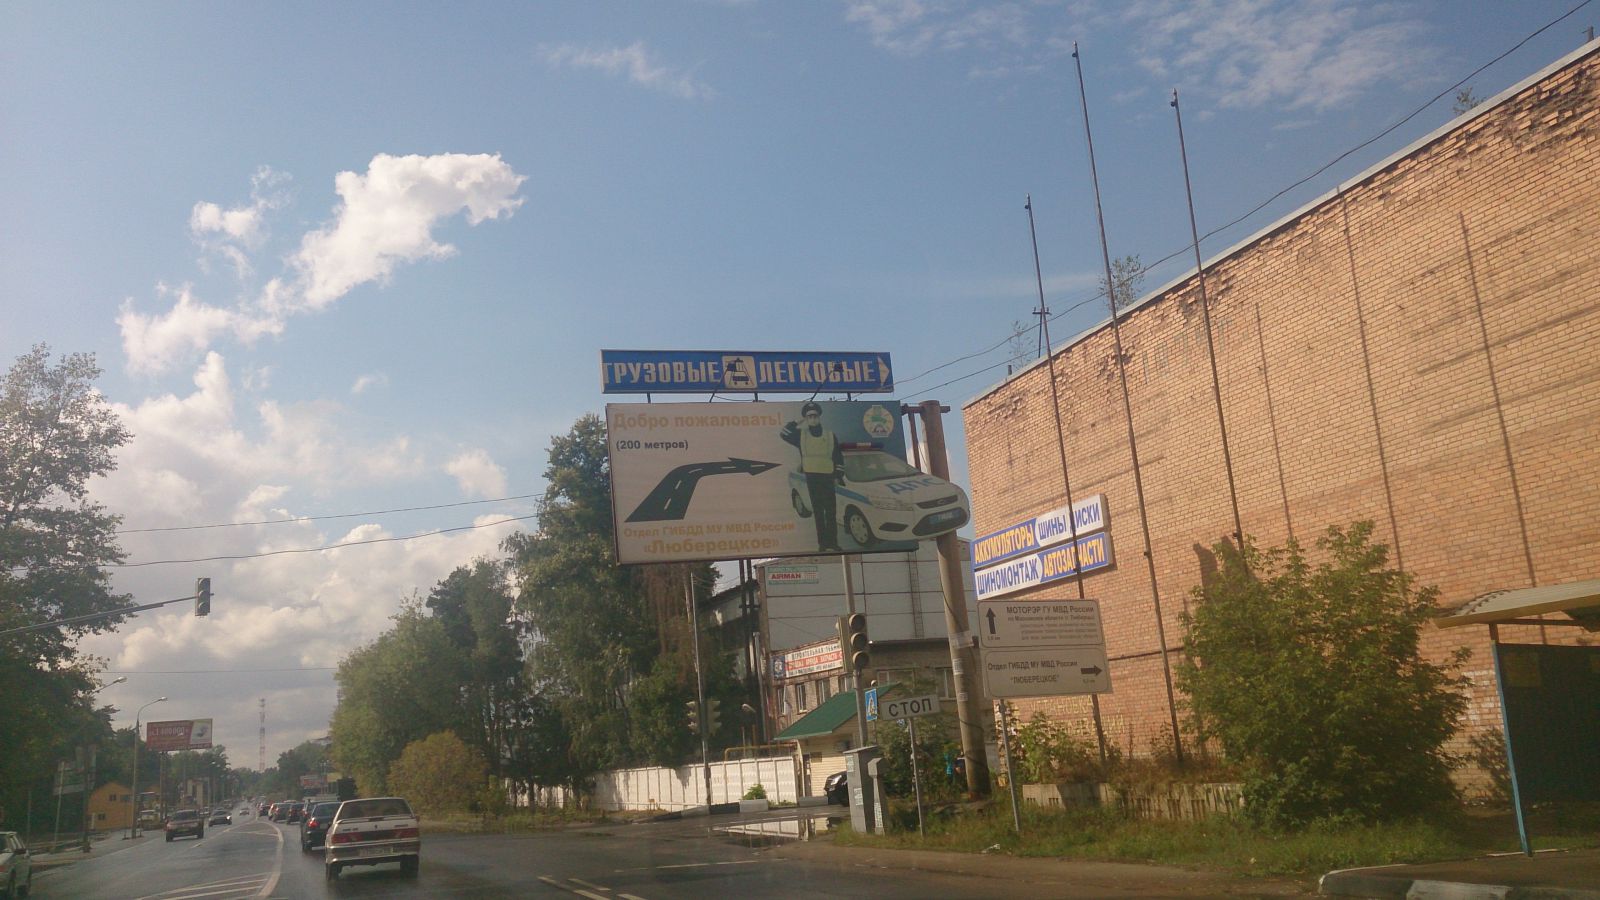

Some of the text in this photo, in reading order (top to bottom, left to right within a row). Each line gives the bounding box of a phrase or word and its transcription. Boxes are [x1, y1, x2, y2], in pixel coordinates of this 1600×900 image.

[602, 360, 876, 384] ГРУЗОВЫЕ ЛЕГКОВЫЕ
[613, 412, 783, 431] Добро пожаловать!
[615, 440, 689, 452] (200 метров)
[726, 523, 751, 534] МВД
[753, 522, 795, 532] России
[974, 502, 1100, 564] АККУМУЛЯТОРЫ ШИНЫ ИСКИ
[977, 557, 1039, 595] ШИНОМОНТАЖ
[888, 698, 932, 717] СТОП
